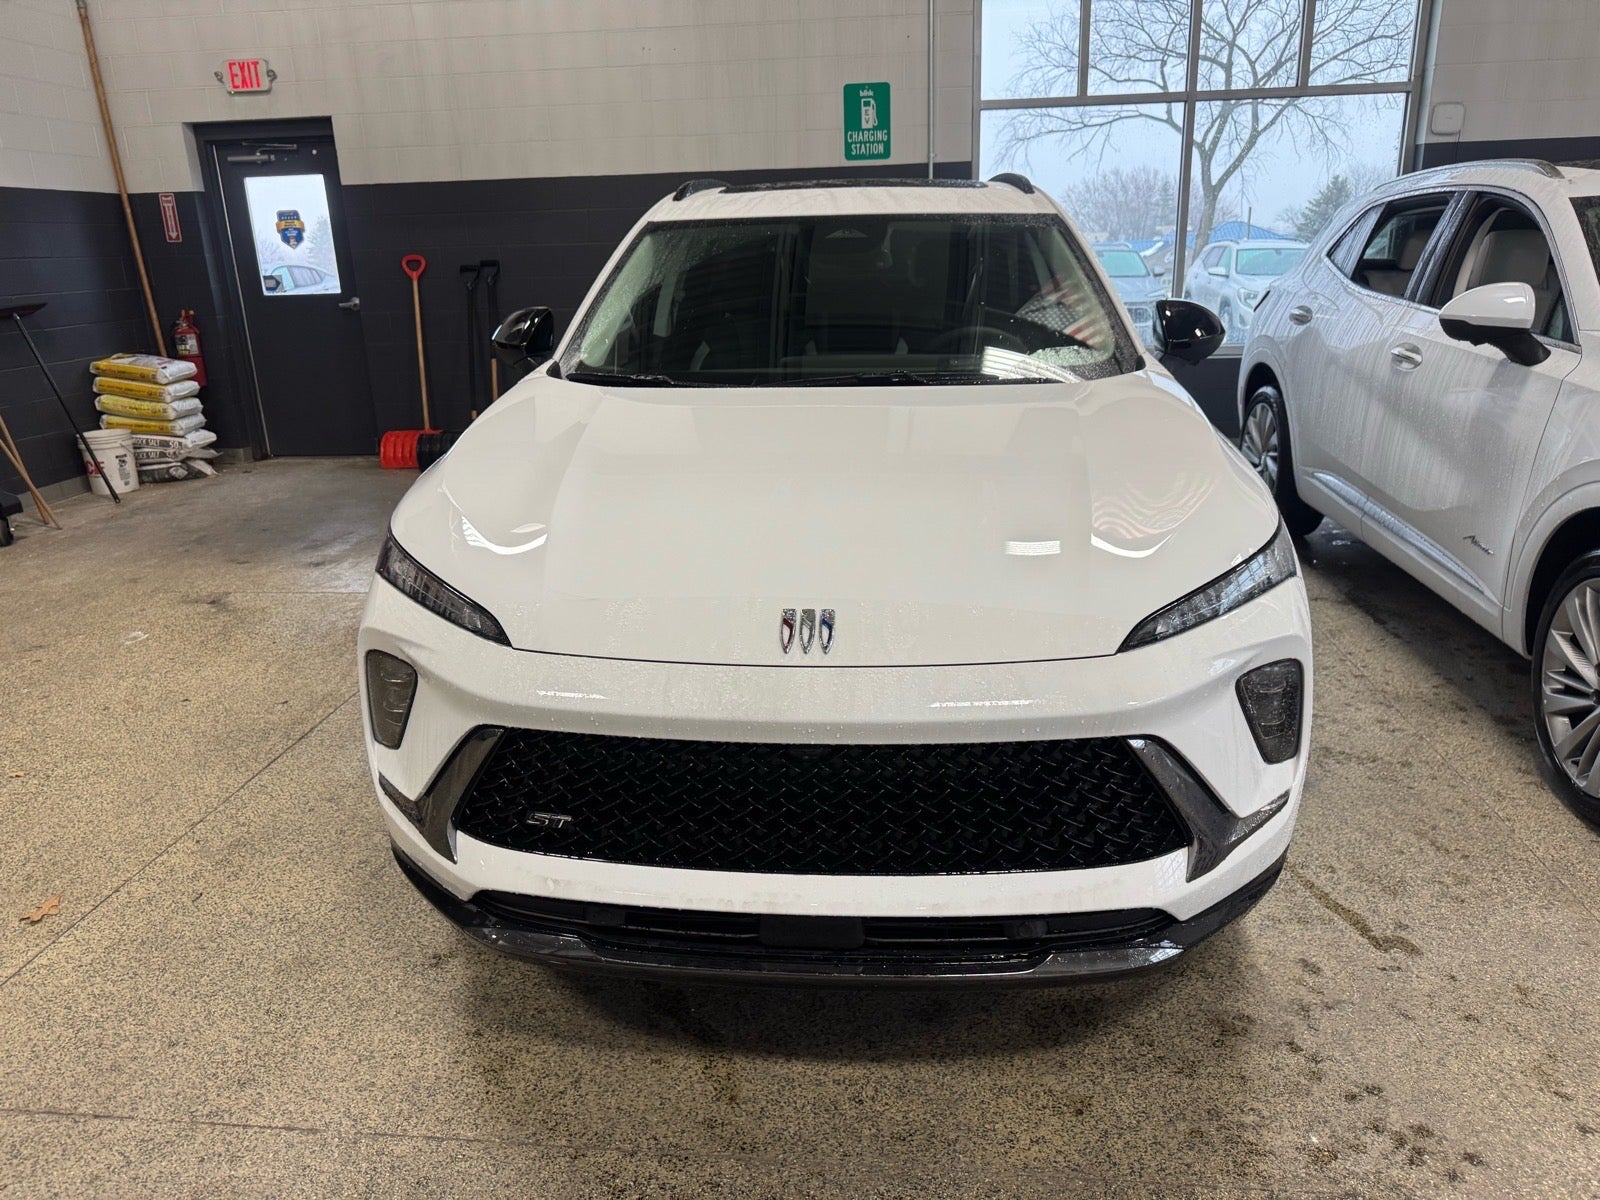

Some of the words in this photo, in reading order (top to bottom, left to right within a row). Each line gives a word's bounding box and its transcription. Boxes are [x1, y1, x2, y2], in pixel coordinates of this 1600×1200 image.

[228, 61, 261, 89] EXIT
[847, 130, 888, 142] CHARGING
[851, 143, 884, 155] STATION
[169, 440, 179, 449] 50
[526, 811, 572, 829] ST
